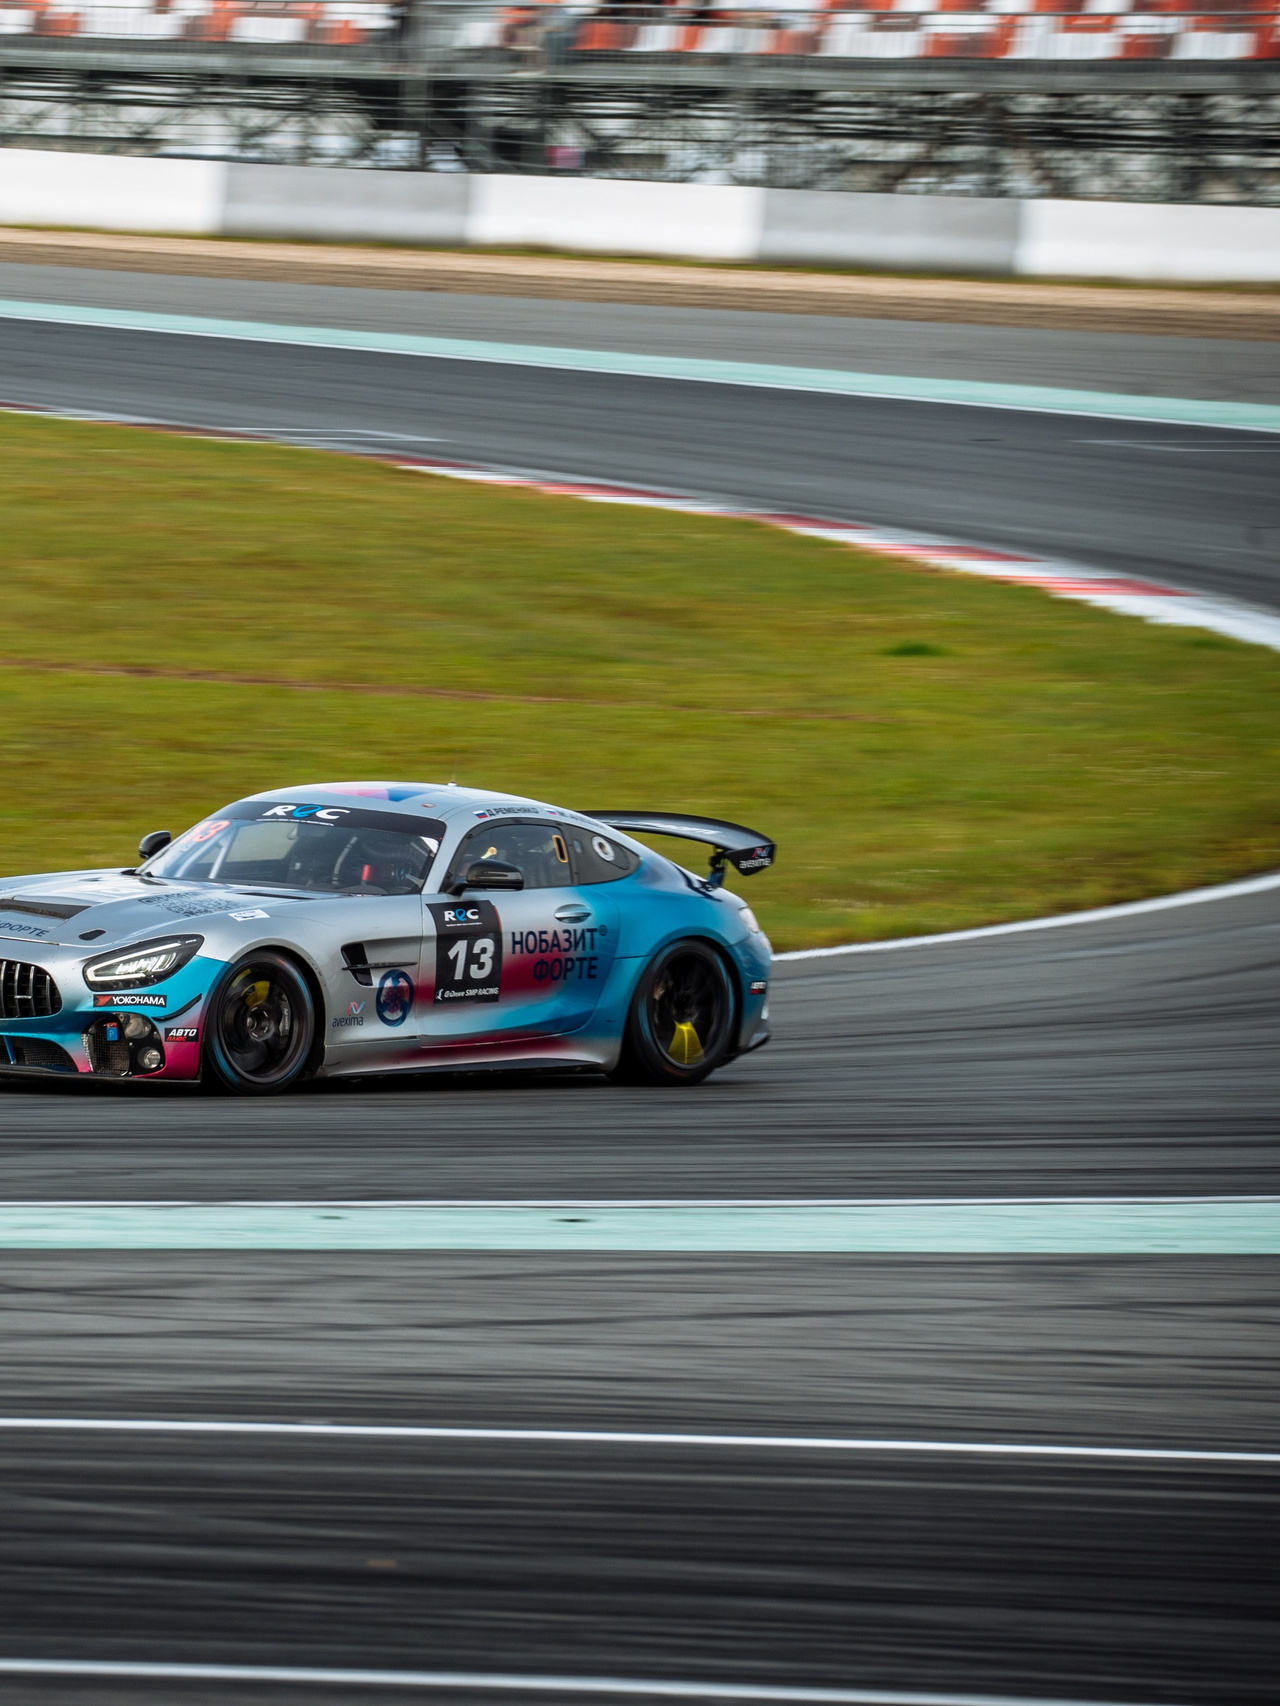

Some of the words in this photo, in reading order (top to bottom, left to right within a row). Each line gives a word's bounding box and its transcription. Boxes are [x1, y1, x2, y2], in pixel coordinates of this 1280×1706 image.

[447, 938, 495, 980] 13
[532, 956, 598, 982] ФОРТЕ
[112, 995, 166, 1006] YOKOHAMA
[332, 1014, 364, 1028] avexima
[168, 1028, 198, 1037] АВТО
